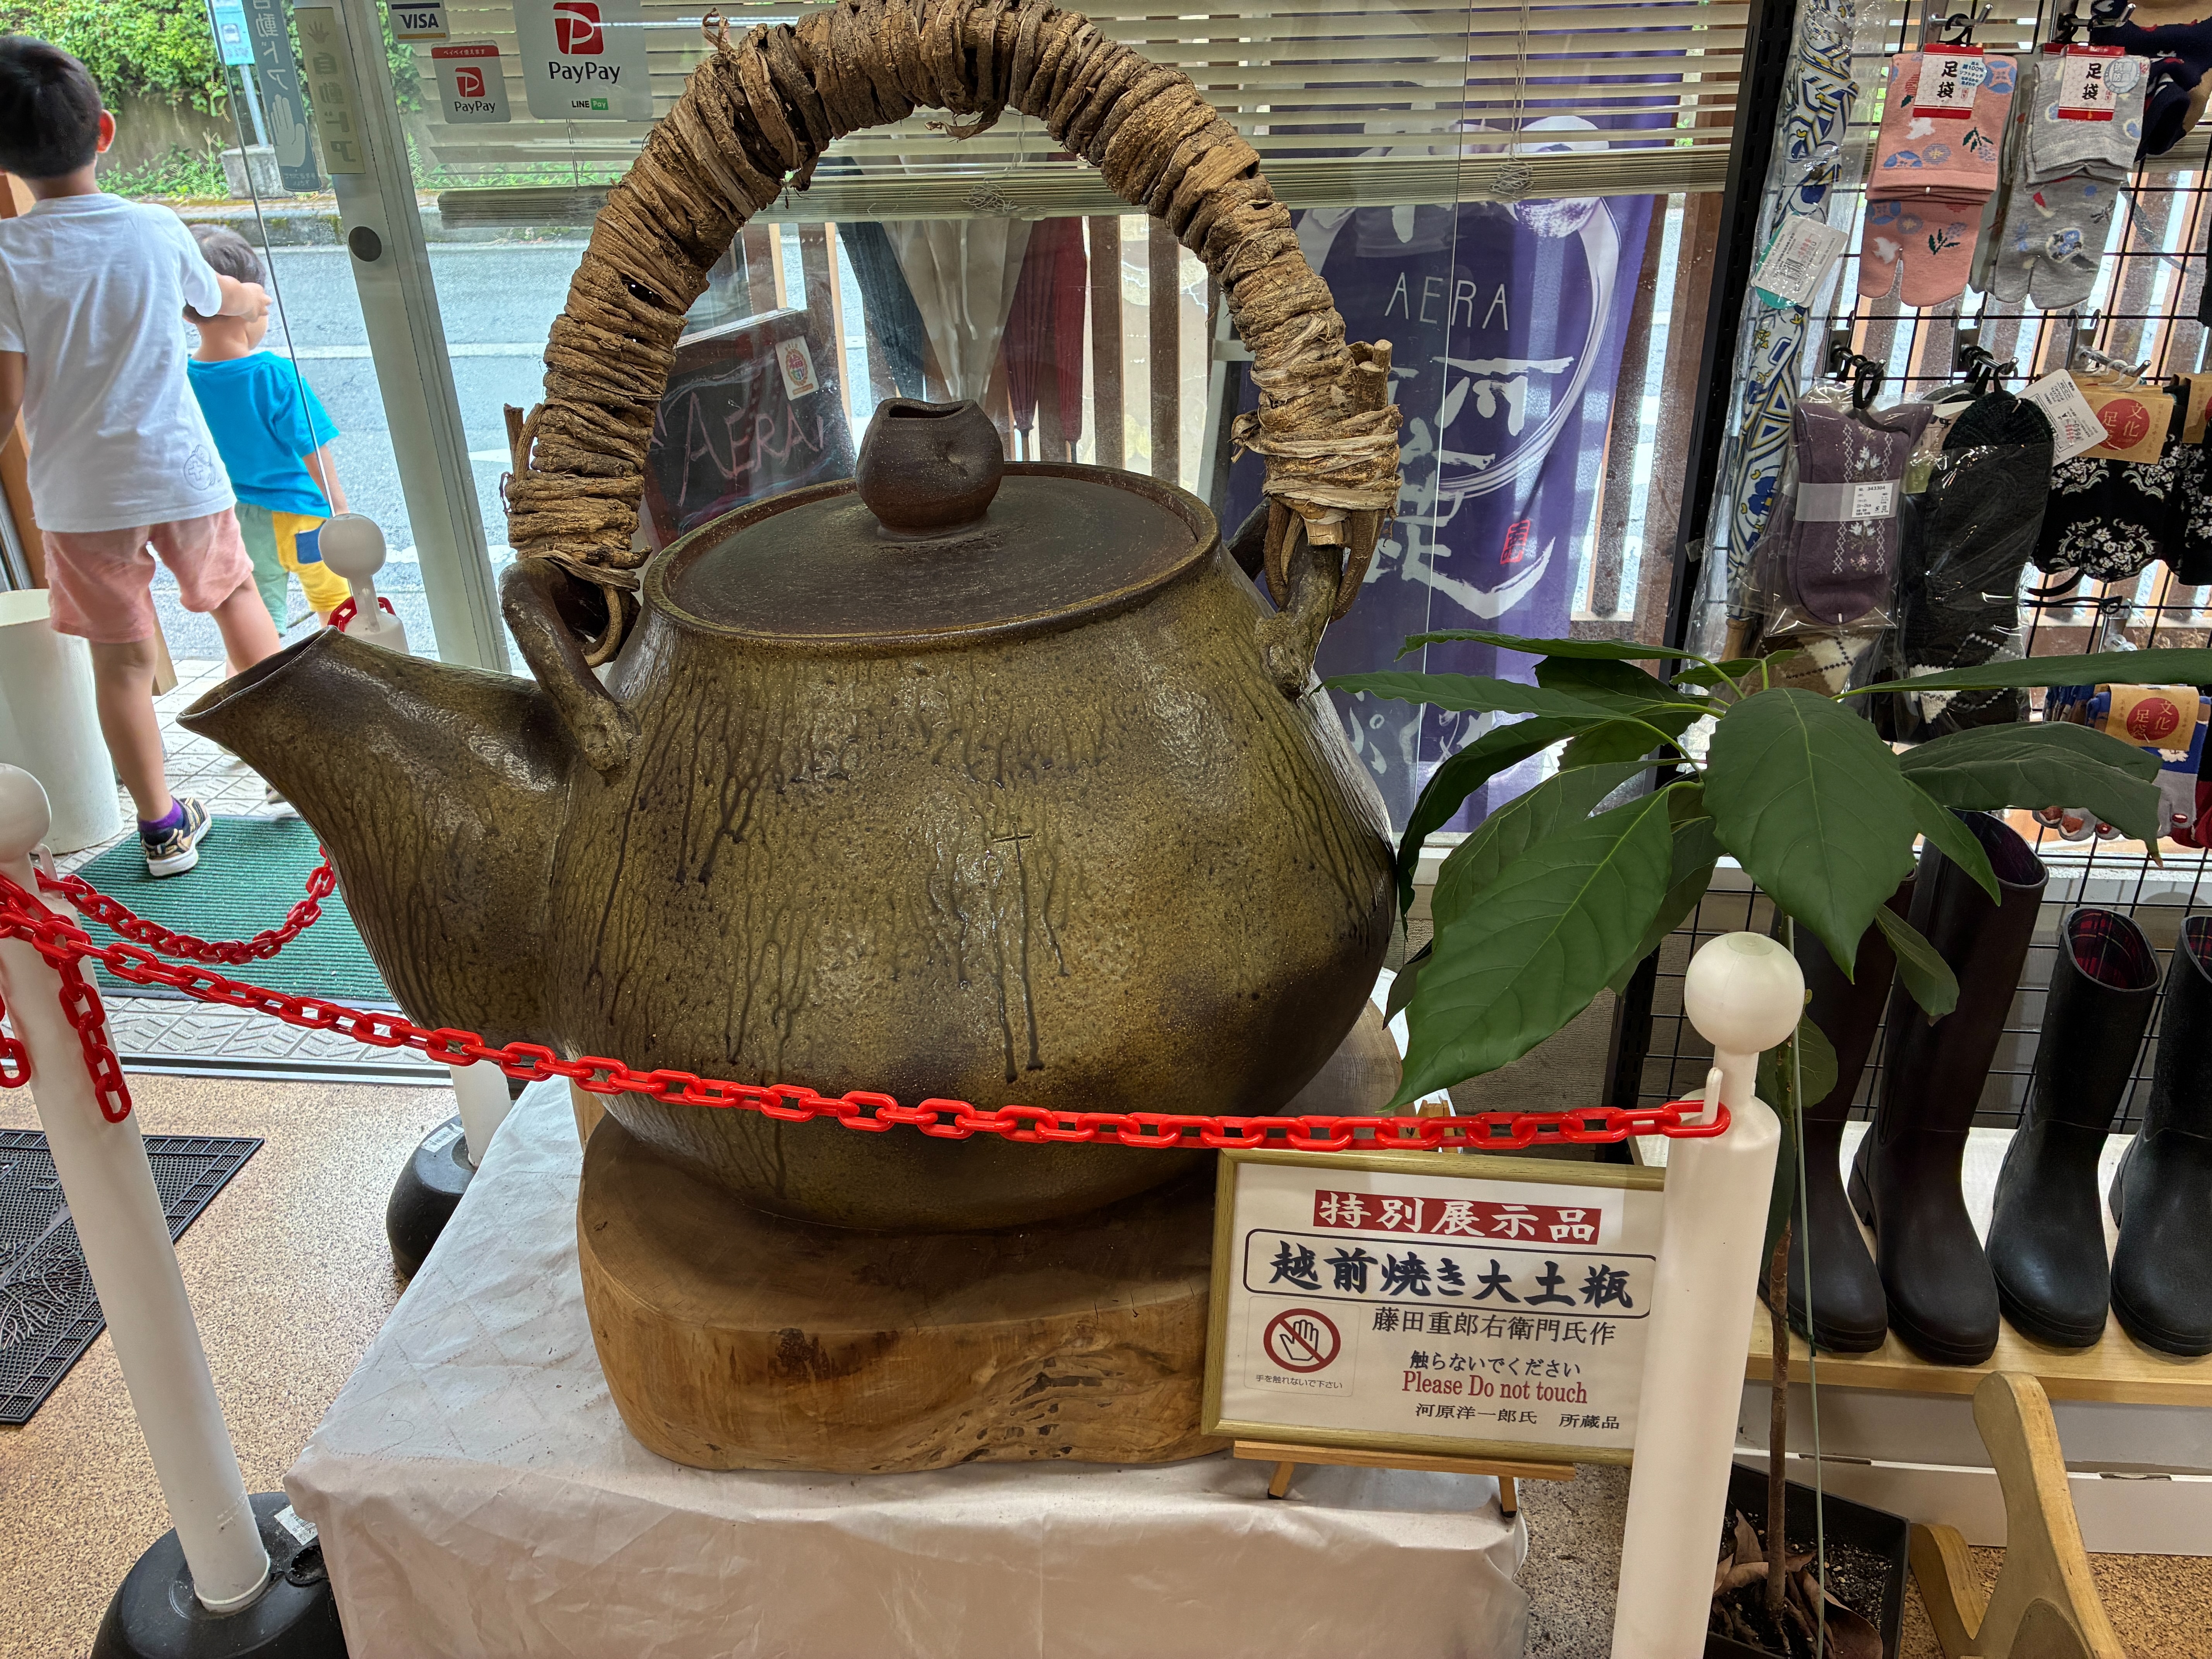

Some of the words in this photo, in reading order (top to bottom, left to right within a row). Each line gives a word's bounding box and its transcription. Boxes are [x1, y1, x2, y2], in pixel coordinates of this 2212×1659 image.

[398, 14, 439, 29] VISA
[548, 61, 620, 84] PayPay
[1937, 60, 1958, 98] 足袋
[2082, 63, 2102, 100] 足袋
[454, 100, 496, 114] PayPay
[572, 100, 590, 108] LINE
[1384, 272, 1508, 331] AERA
[2123, 402, 2144, 437] 文化
[2154, 700, 2174, 730] 文化
[1318, 1192, 1596, 1242] 特別展示品
[1268, 1240, 1634, 1310] 越前焼き大土瓶
[1372, 1307, 1616, 1346] 藤田重郎右衛門氏作
[1409, 1350, 1581, 1378] 触らないでください
[1255, 1374, 1343, 1389] 手を触れないで下さい
[1401, 1370, 1463, 1395] Please
[1468, 1374, 1494, 1397] Do
[1499, 1381, 1530, 1400] not
[1536, 1381, 1588, 1404] touch
[1415, 1403, 1537, 1424] 河原洋一郎氏
[1559, 1413, 1620, 1430] 所蔵品
